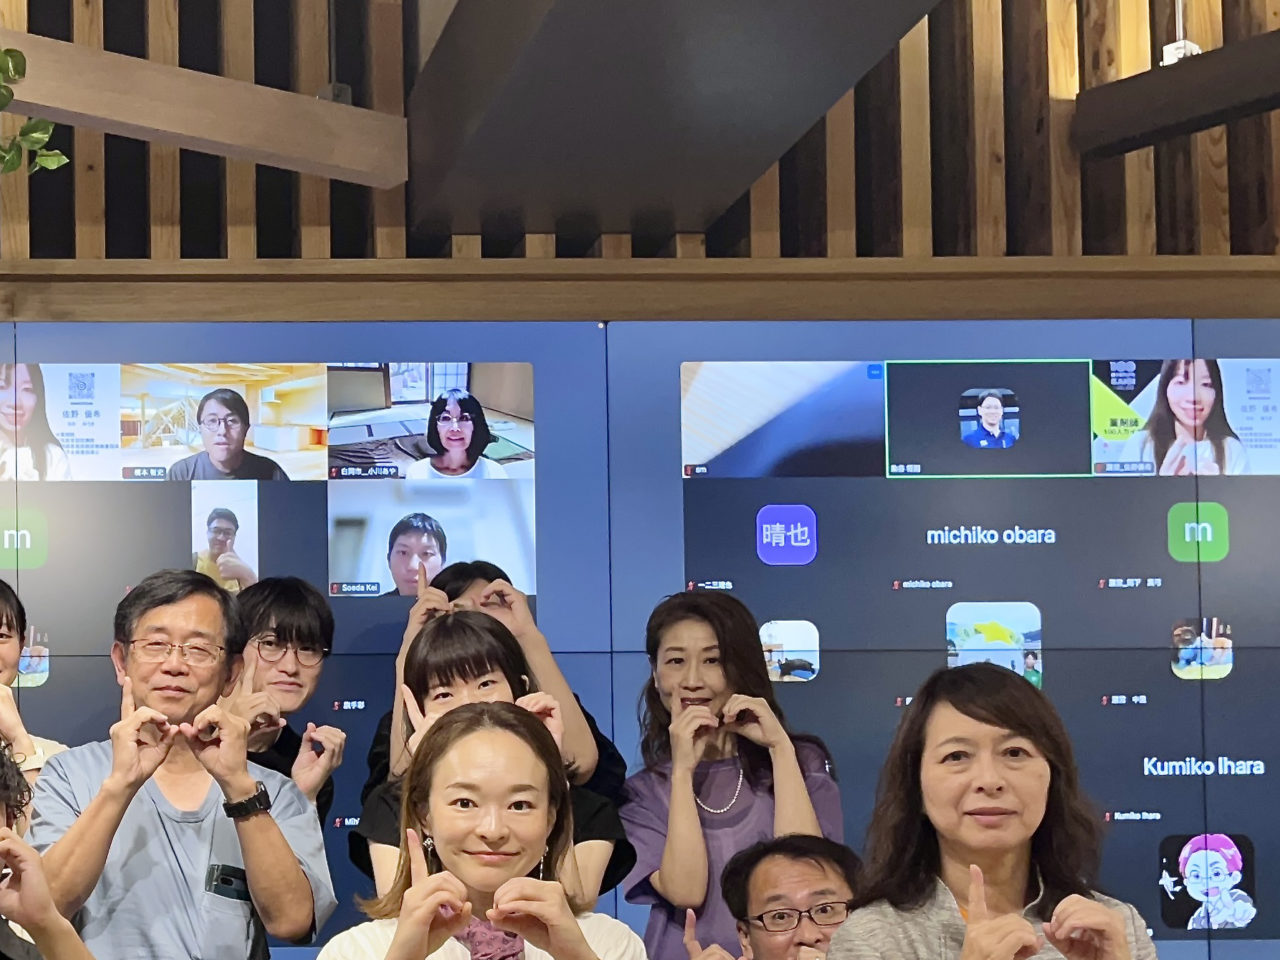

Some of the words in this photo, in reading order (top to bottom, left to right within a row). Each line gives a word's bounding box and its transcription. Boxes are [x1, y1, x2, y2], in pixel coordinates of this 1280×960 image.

[3, 529, 31, 549] m
[762, 522, 811, 547] 晴也
[926, 525, 999, 545] michiko
[1002, 525, 1056, 544] obara
[1184, 521, 1212, 542] m
[1143, 757, 1215, 776] Kumiko
[1218, 757, 1265, 775] Ihara
